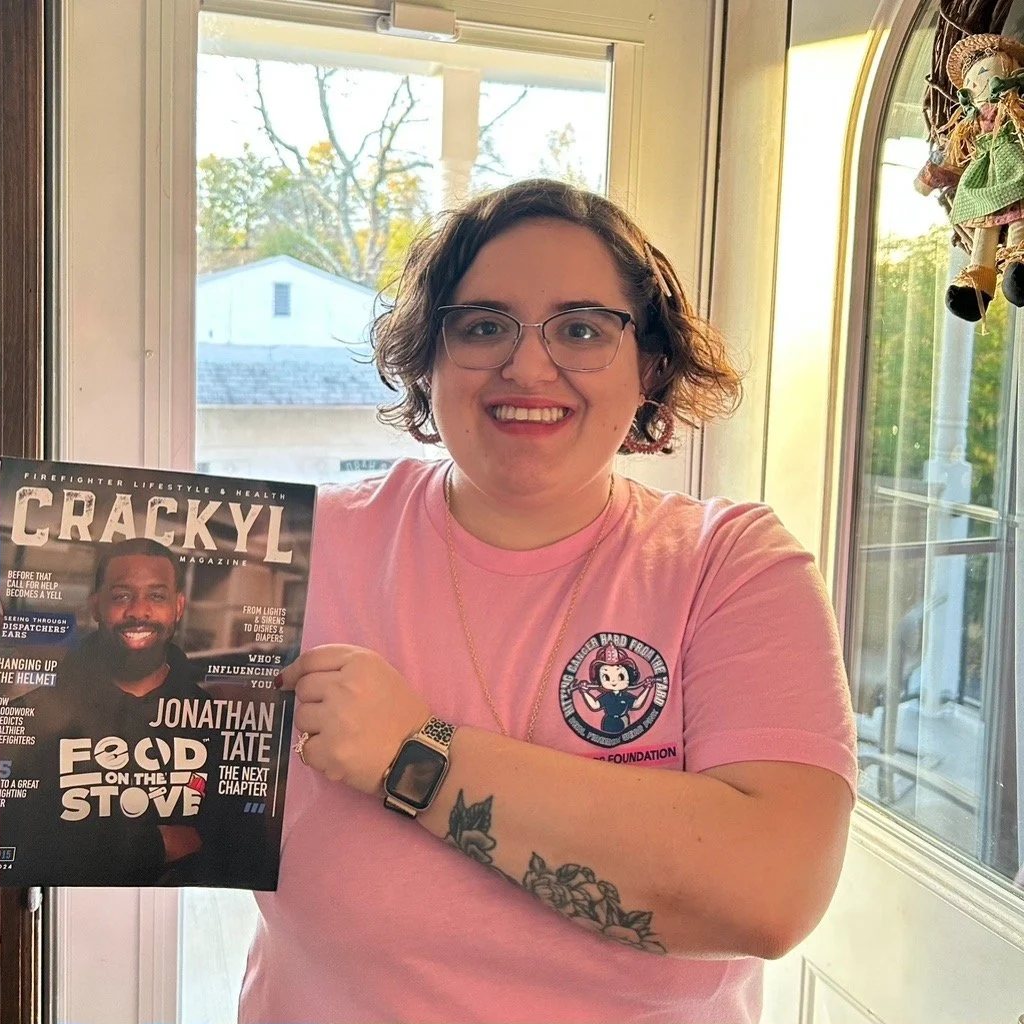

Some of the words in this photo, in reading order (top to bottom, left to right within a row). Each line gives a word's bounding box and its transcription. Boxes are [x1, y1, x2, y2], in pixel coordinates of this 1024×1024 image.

[24, 472, 123, 487] FIREFIGHTER
[134, 481, 210, 495] LIFESTYLE
[236, 489, 286, 500] HEALTH
[11, 486, 293, 564] CRACKYL
[179, 556, 248, 567] MAGAZINE
[7, 570, 34, 580] BEFORE
[36, 572, 52, 580] THAT
[7, 580, 24, 588] CALL
[26, 581, 39, 589] FOR
[41, 582, 58, 590] HELP
[6, 589, 38, 598] BECOMES
[39, 590, 45, 598] A
[46, 591, 62, 600] YELL
[243, 606, 261, 615] FROM
[263, 607, 286, 617] LIGHTS
[255, 616, 260, 624] &
[262, 616, 285, 625] SIRENS
[2, 630, 27, 639] EARS
[244, 624, 253, 632] TO
[255, 624, 277, 634] DISHES
[279, 626, 284, 634] &
[255, 634, 284, 643] DIAPERS
[248, 654, 281, 664] WHO'S
[599, 633, 628, 646] HARD
[629, 639, 656, 661] FROM
[650, 654, 667, 675] THE
[0, 658, 41, 671] HANGING
[45, 660, 57, 672] UP
[207, 665, 280, 677] INFLUENCING
[0, 671, 14, 684] HE
[16, 672, 56, 686] HELMET
[251, 680, 276, 689] YOU
[149, 697, 275, 731] JONATHAN
[220, 731, 273, 763] TATE
[59, 736, 208, 774] FOOD
[607, 746, 676, 764] FOUNDATION
[105, 771, 129, 785] ON
[134, 772, 167, 785] THE
[219, 765, 239, 781] THE
[241, 767, 270, 783] NEXT
[1, 779, 10, 788] TO
[11, 780, 16, 788] A
[17, 779, 40, 789] GREAT
[218, 780, 268, 797] CHAPTER
[60, 785, 202, 821] STOVE
